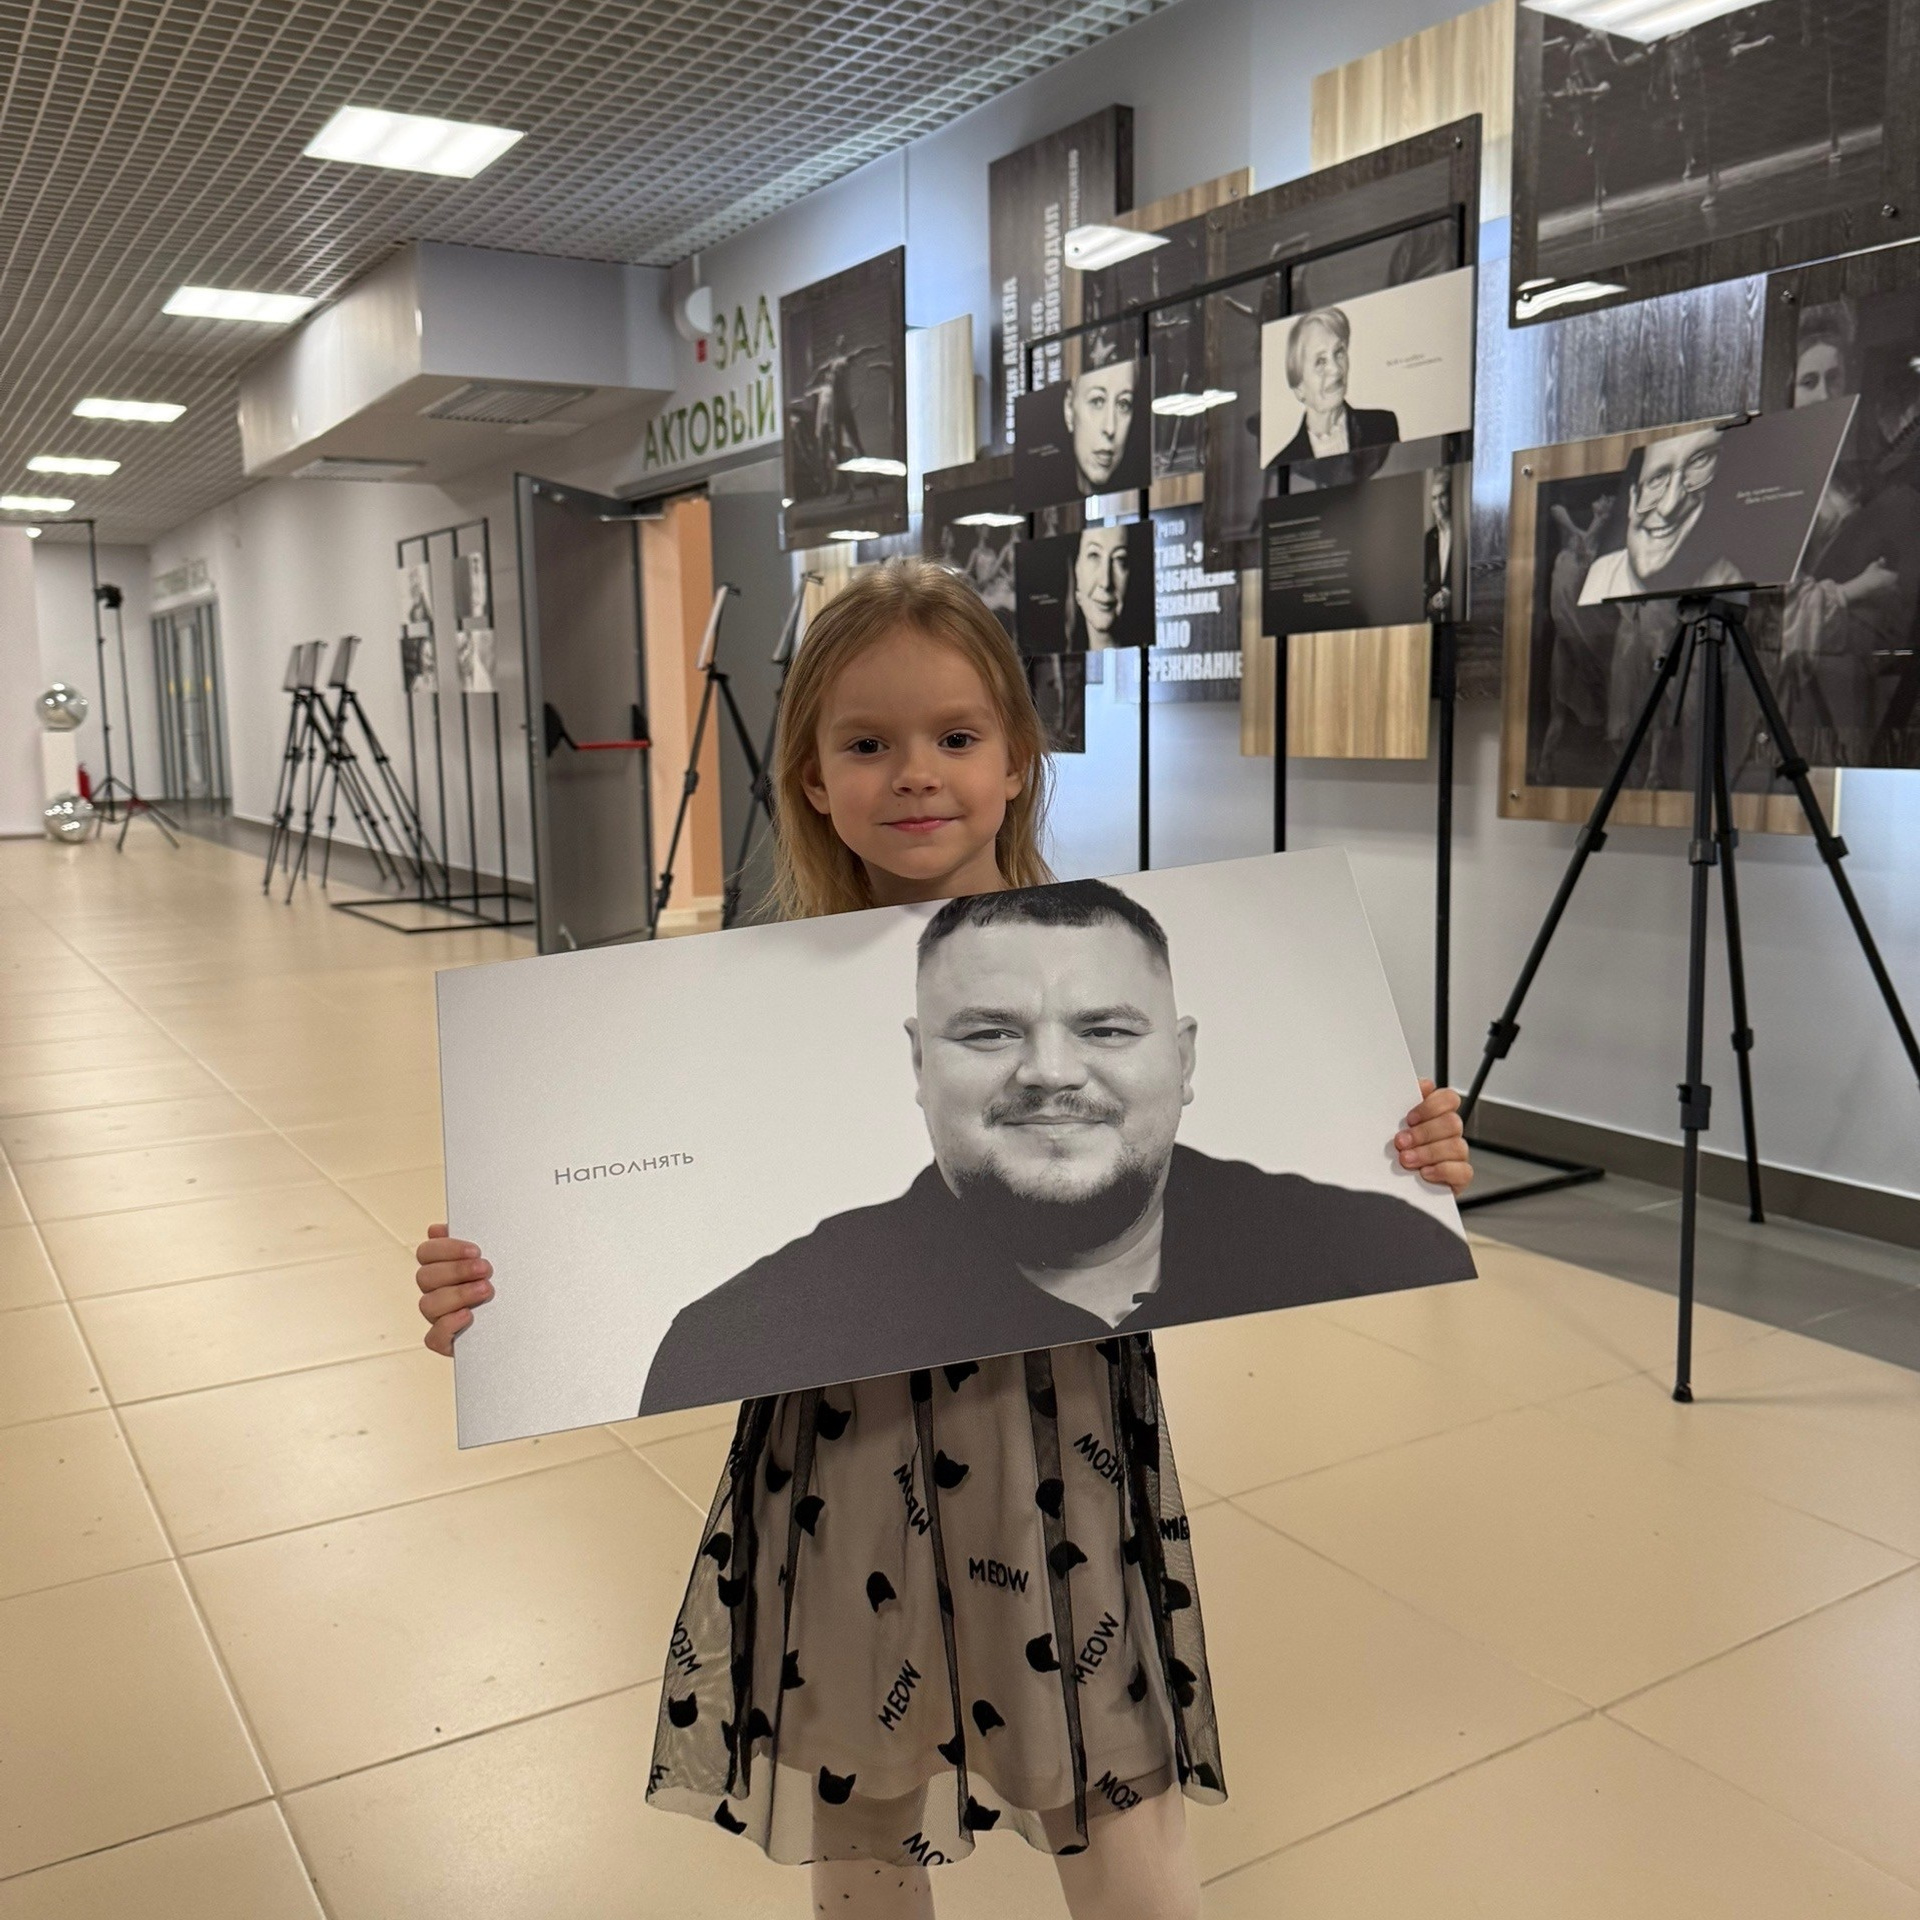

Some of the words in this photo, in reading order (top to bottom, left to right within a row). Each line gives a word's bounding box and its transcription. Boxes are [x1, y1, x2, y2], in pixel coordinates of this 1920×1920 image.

[713, 295, 776, 371] ЗАЛ
[1003, 276, 1019, 365] АНГЕЛА
[643, 360, 776, 471] АКТОВЫЙ
[1153, 620, 1191, 649] АМО
[1149, 651, 1243, 683] РЕЖИВАНИЕ
[554, 1152, 694, 1185] Наполнять
[969, 1557, 1029, 1593] MEOW
[670, 1621, 702, 1676] MEO
[1071, 1611, 1119, 1685] MEOW
[878, 1659, 921, 1731] MEOW
